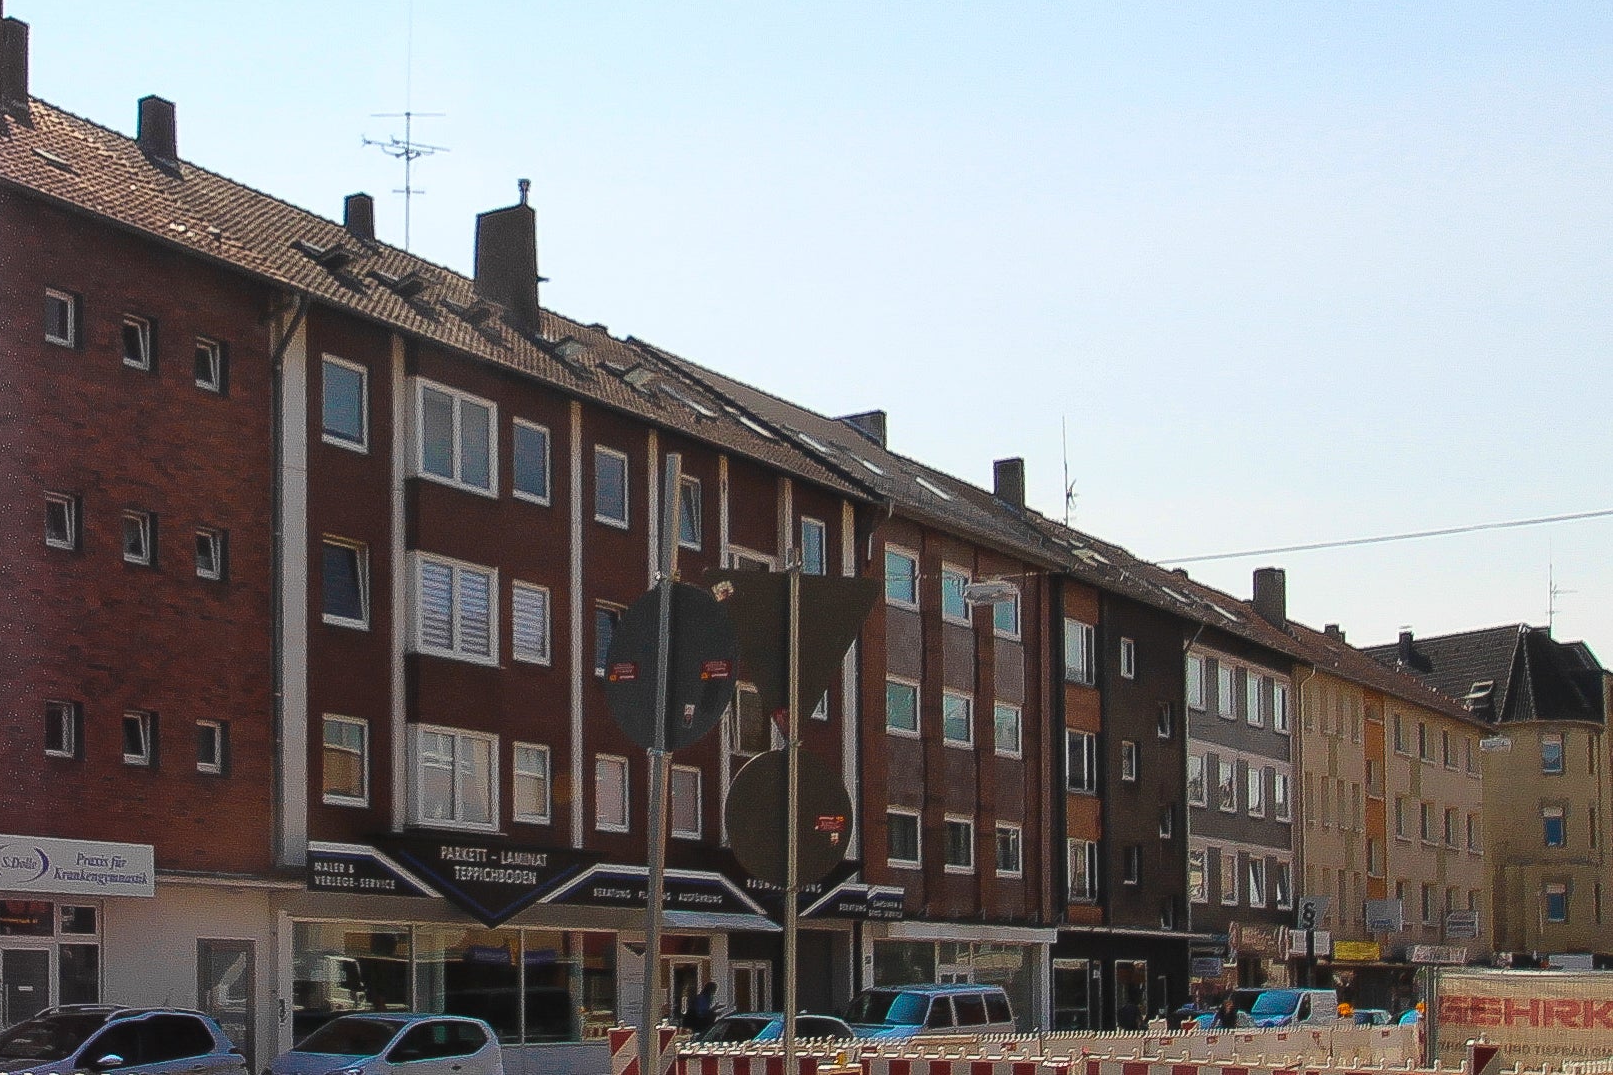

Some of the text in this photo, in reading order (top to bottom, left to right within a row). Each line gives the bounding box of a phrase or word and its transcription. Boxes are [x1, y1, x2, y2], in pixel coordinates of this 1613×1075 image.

[76, 852, 127, 870] Praxis für
[440, 846, 488, 862] PARKETT
[500, 850, 548, 866] LAMINAT
[53, 867, 147, 885] Krankengymnastik
[313, 861, 345, 873] MALER
[454, 865, 537, 885] TEPPICHBODEN
[313, 875, 396, 890] VERLEGE-SERVICE
